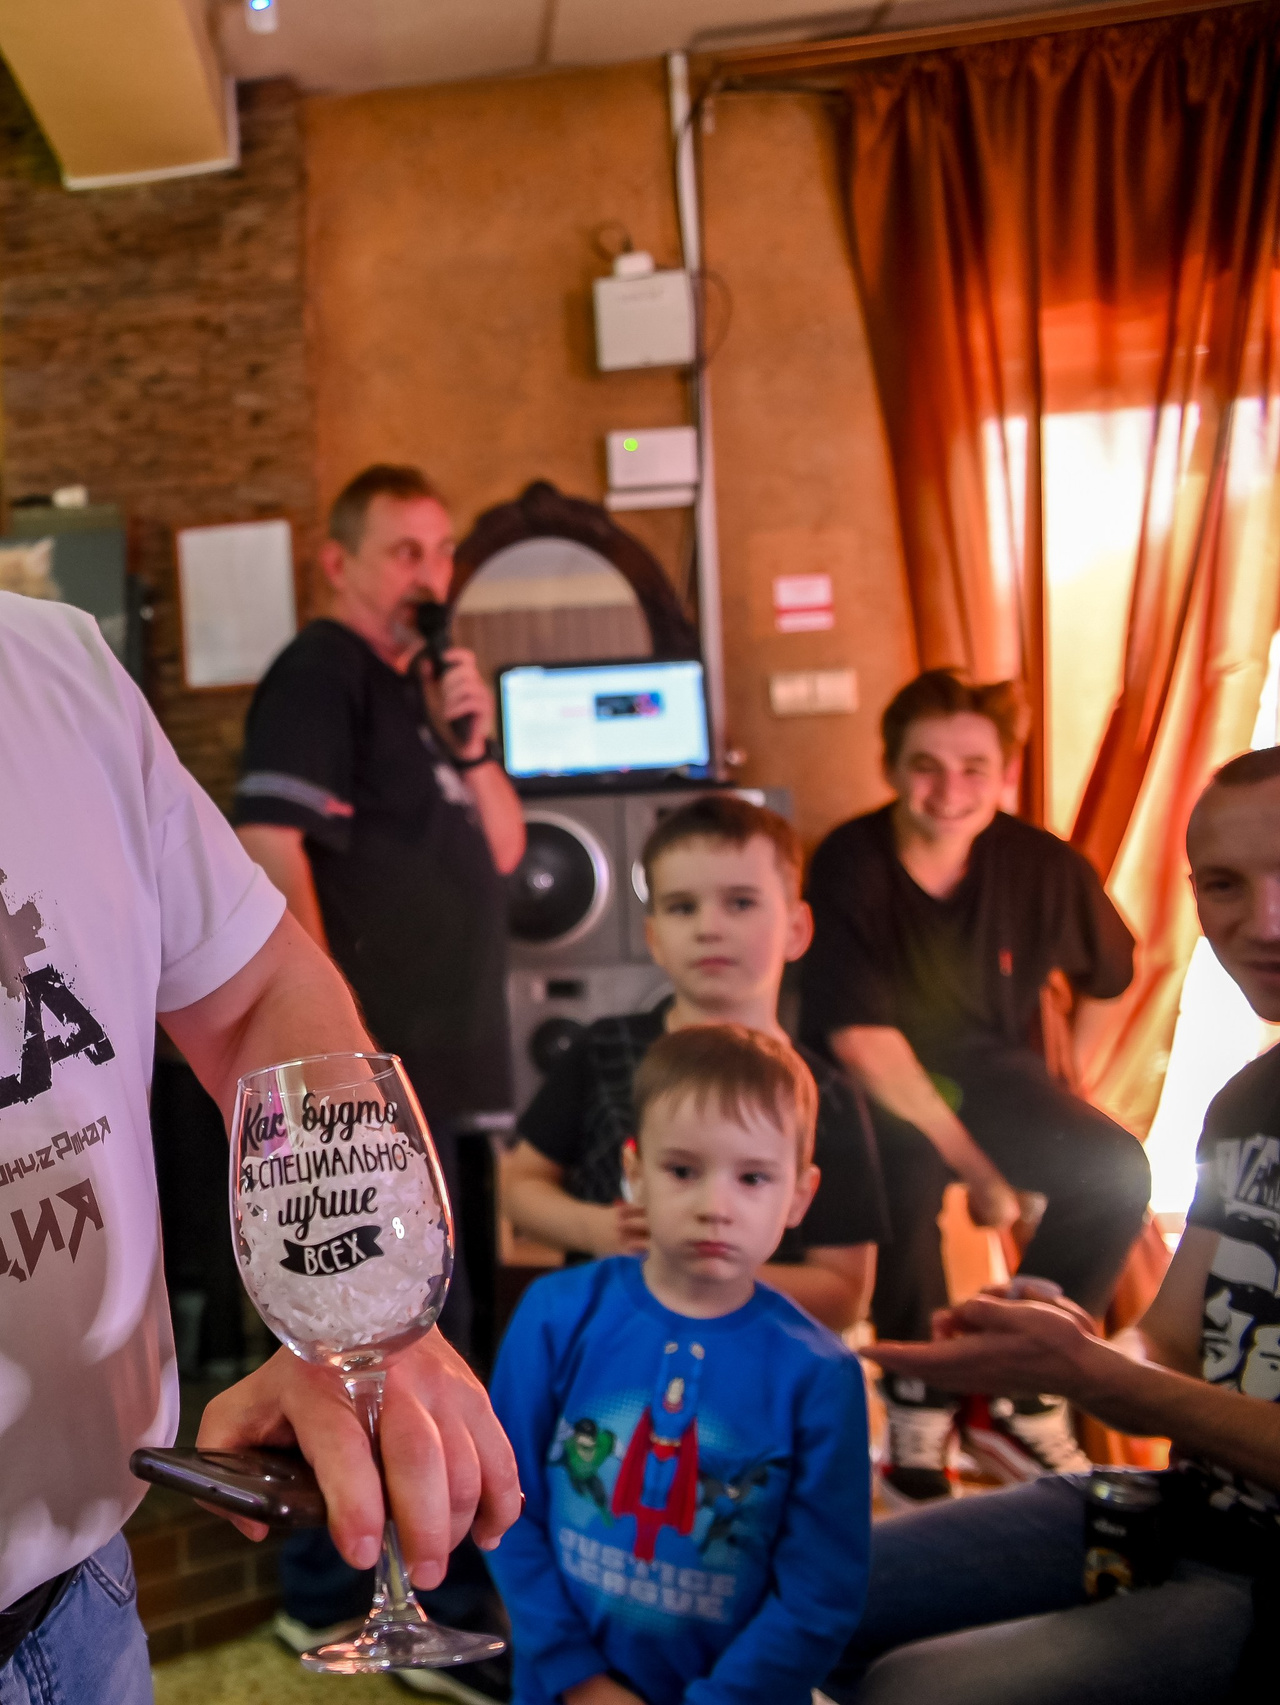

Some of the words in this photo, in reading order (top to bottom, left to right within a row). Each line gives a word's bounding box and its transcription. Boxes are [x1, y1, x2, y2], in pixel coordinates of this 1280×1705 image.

[302, 1092, 397, 1143] будто
[259, 1143, 408, 1189] СПЕЦИАЛЬНО
[278, 1186, 379, 1240] лучше
[303, 1232, 367, 1275] ВСЕХ
[561, 1550, 724, 1624] LEAGUE
